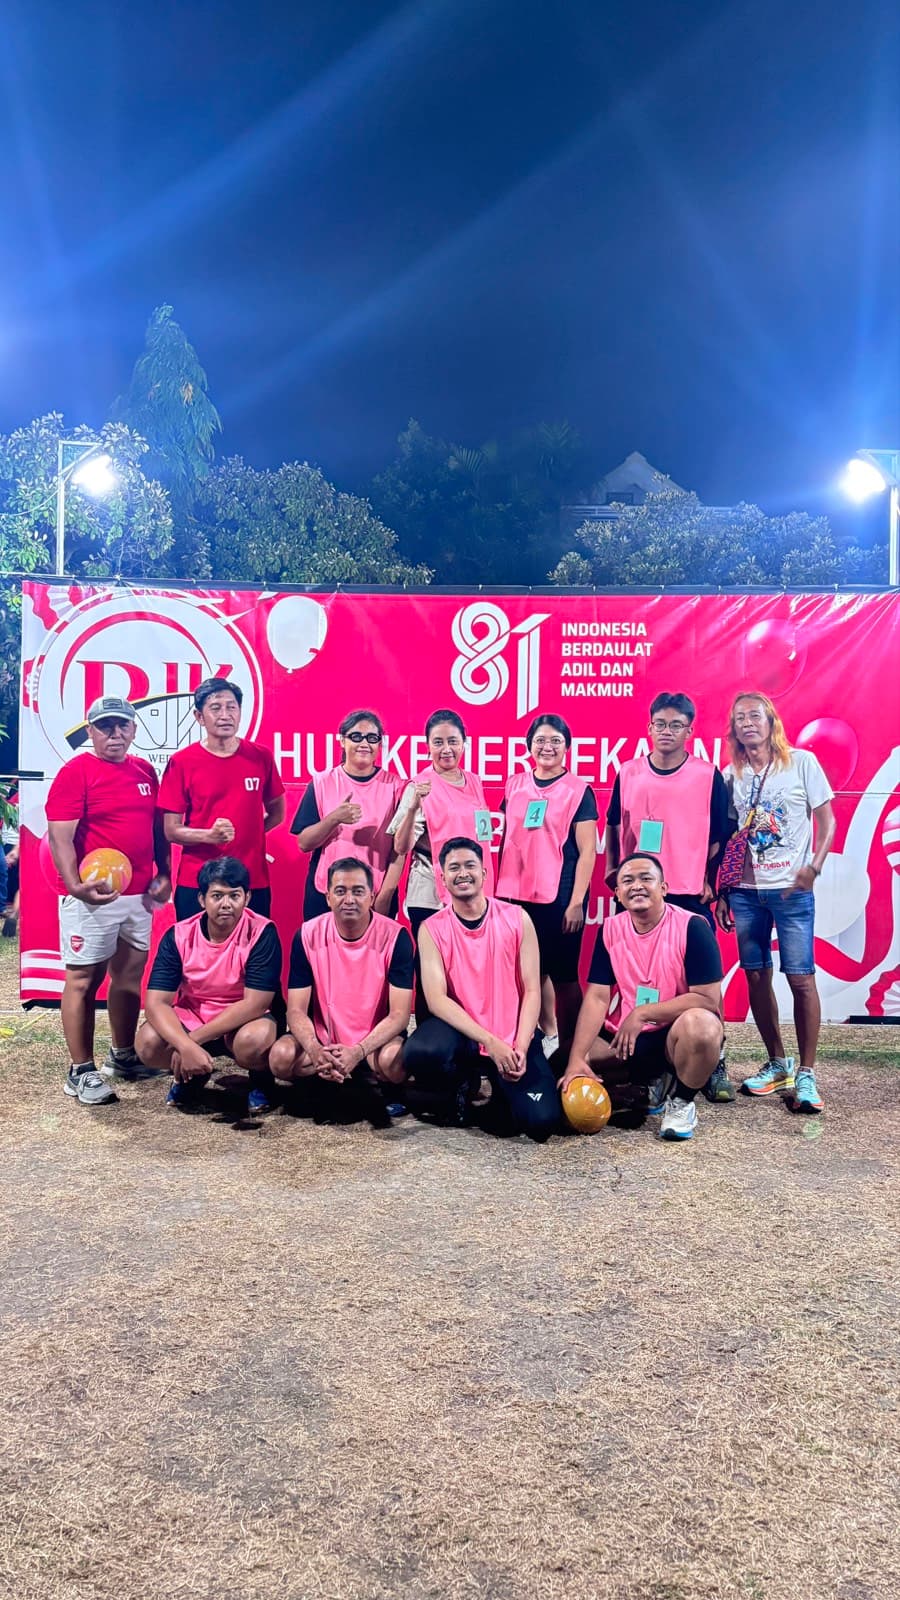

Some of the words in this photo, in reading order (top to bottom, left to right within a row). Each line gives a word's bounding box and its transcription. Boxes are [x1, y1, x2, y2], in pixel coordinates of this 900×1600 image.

[561, 622, 647, 637] INDONESIA
[561, 642, 653, 657] BERDAULAT
[450, 601, 552, 720] 81
[560, 662, 597, 677] ADIL
[600, 662, 634, 677] DAN
[560, 683, 634, 697] MAKMUR
[273, 732, 343, 778] HU
[137, 783, 152, 796] 07
[244, 777, 260, 791] 07
[530, 807, 541, 822] 4
[479, 818, 488, 836] 2
